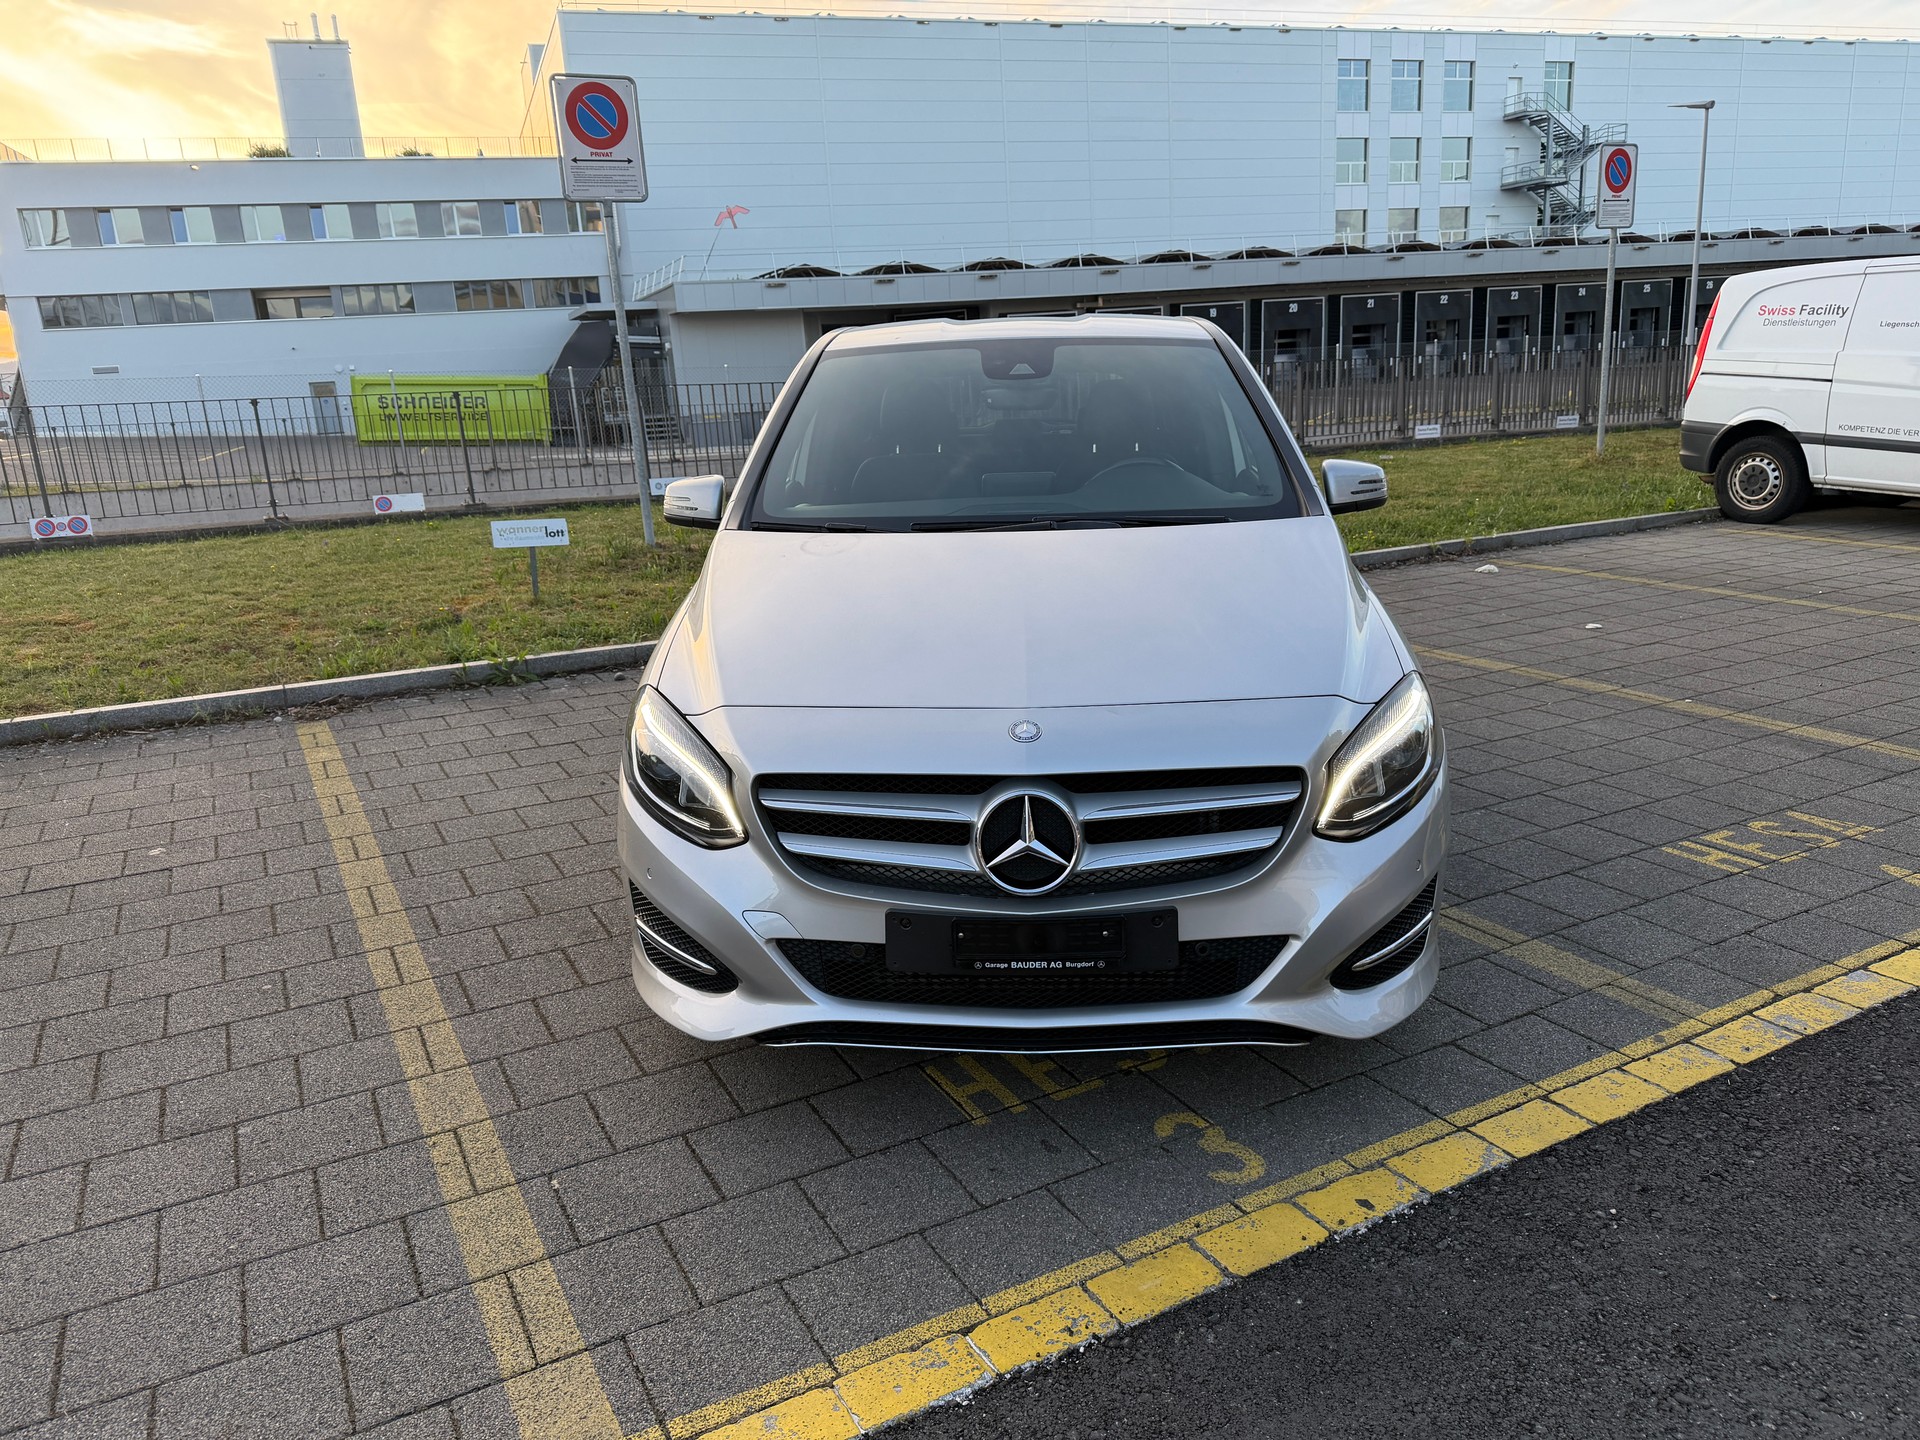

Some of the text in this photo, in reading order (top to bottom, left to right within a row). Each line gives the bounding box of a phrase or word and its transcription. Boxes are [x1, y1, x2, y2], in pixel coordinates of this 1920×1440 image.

[1643, 284, 1651, 293] 25
[1705, 280, 1714, 290] 26
[1510, 291, 1519, 300] 23
[1578, 287, 1587, 297] 24
[1366, 299, 1375, 308] 21
[1439, 295, 1449, 304] 22
[1209, 308, 1217, 318] 19
[1288, 303, 1298, 313] 20
[1758, 304, 1850, 318] Swiss Facility
[1762, 318, 1836, 328] Dienstleistungen
[1838, 424, 1886, 434] KOMPETENZ
[1887, 427, 1901, 436] DIE
[1010, 961, 1047, 969] BAUDER
[1049, 961, 1063, 969] AG
[1065, 961, 1095, 969] Burgdorf
[1153, 1111, 1267, 1185] 3
